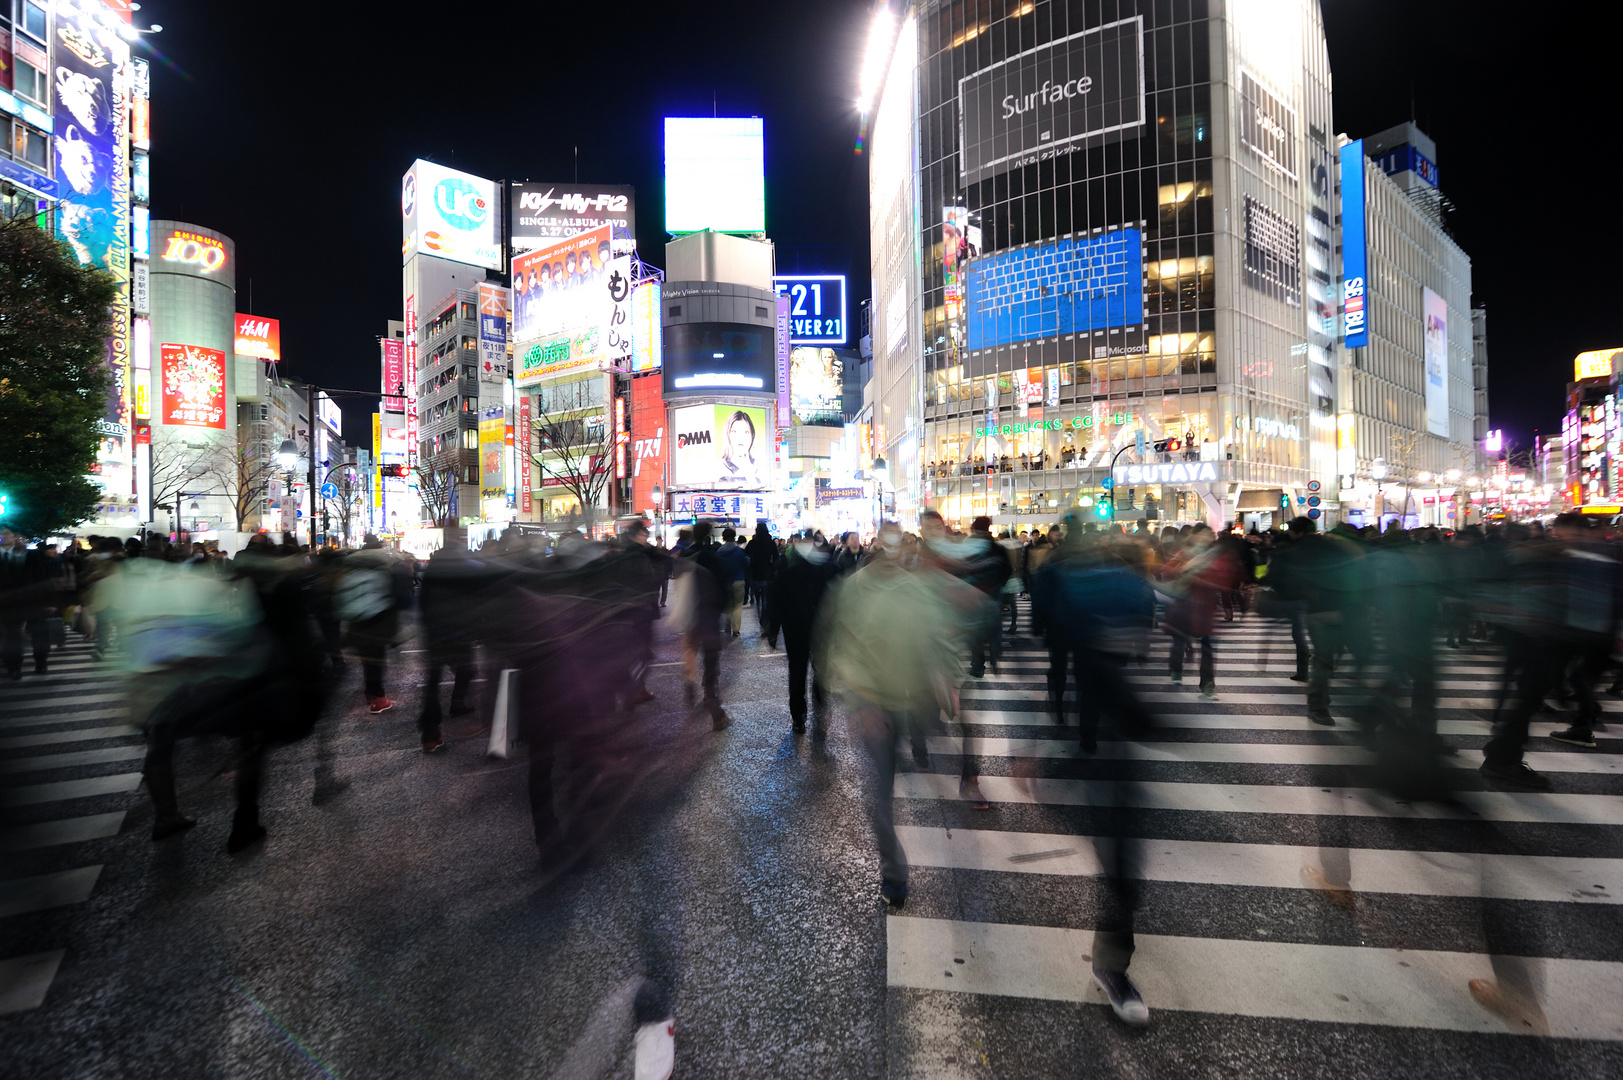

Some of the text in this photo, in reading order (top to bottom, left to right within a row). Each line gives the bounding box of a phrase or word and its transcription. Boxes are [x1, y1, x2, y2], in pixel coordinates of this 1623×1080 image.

[1002, 73, 1093, 120] Surface
[174, 230, 225, 249] SHIBUYA
[161, 236, 226, 273] 109
[474, 247, 497, 259] VISA
[138, 267, 147, 310] 渋谷駅前ビル
[681, 288, 699, 296] Vision
[481, 289, 507, 317] 本
[608, 269, 629, 352] もんじゃ
[1344, 277, 1364, 337] SEIBU
[111, 295, 128, 368] MISSION
[240, 319, 269, 339] H&M
[825, 318, 841, 336] 21
[482, 341, 506, 353] 夜11時
[487, 351, 501, 361] まで
[777, 311, 788, 394] Taisei neon
[1109, 343, 1149, 355] Microsoft
[386, 341, 399, 408] Essential
[494, 364, 506, 374] 地下
[976, 418, 1063, 438] STARBUCKS
[678, 430, 711, 449] DMM
[1113, 462, 1217, 484] TSUTAYA
